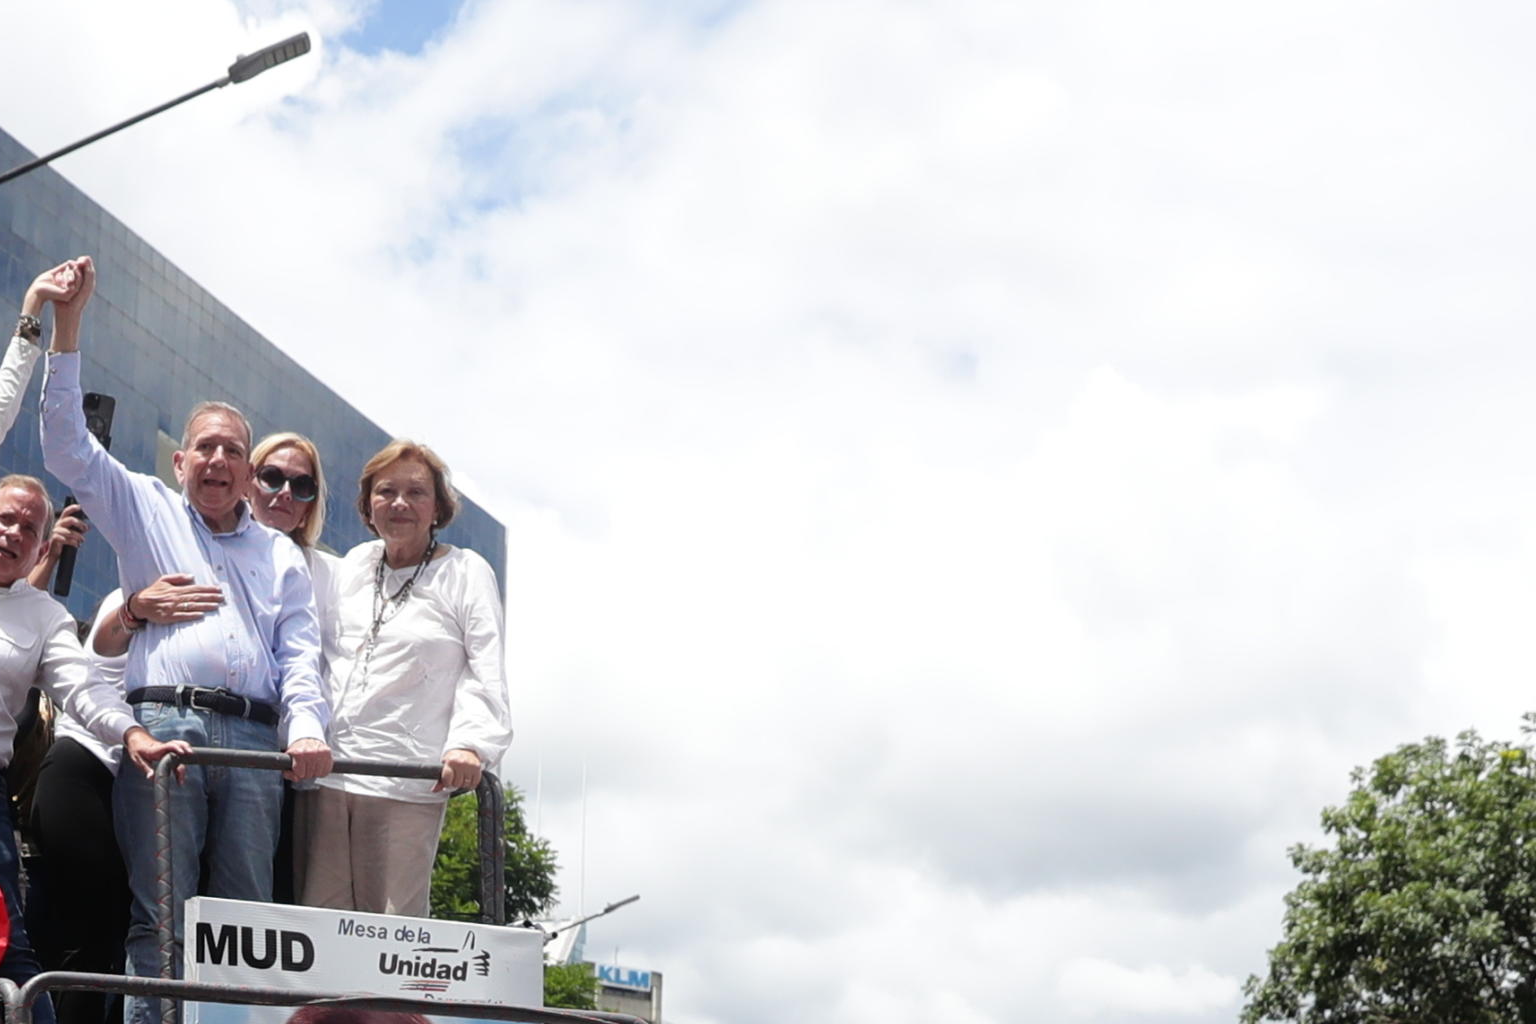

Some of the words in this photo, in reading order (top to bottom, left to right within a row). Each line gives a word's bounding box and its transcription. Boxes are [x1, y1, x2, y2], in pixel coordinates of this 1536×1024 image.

[338, 918, 387, 940] Mesa
[195, 922, 315, 972] MUD
[379, 952, 468, 981] Unidad
[599, 966, 649, 988] KLM
